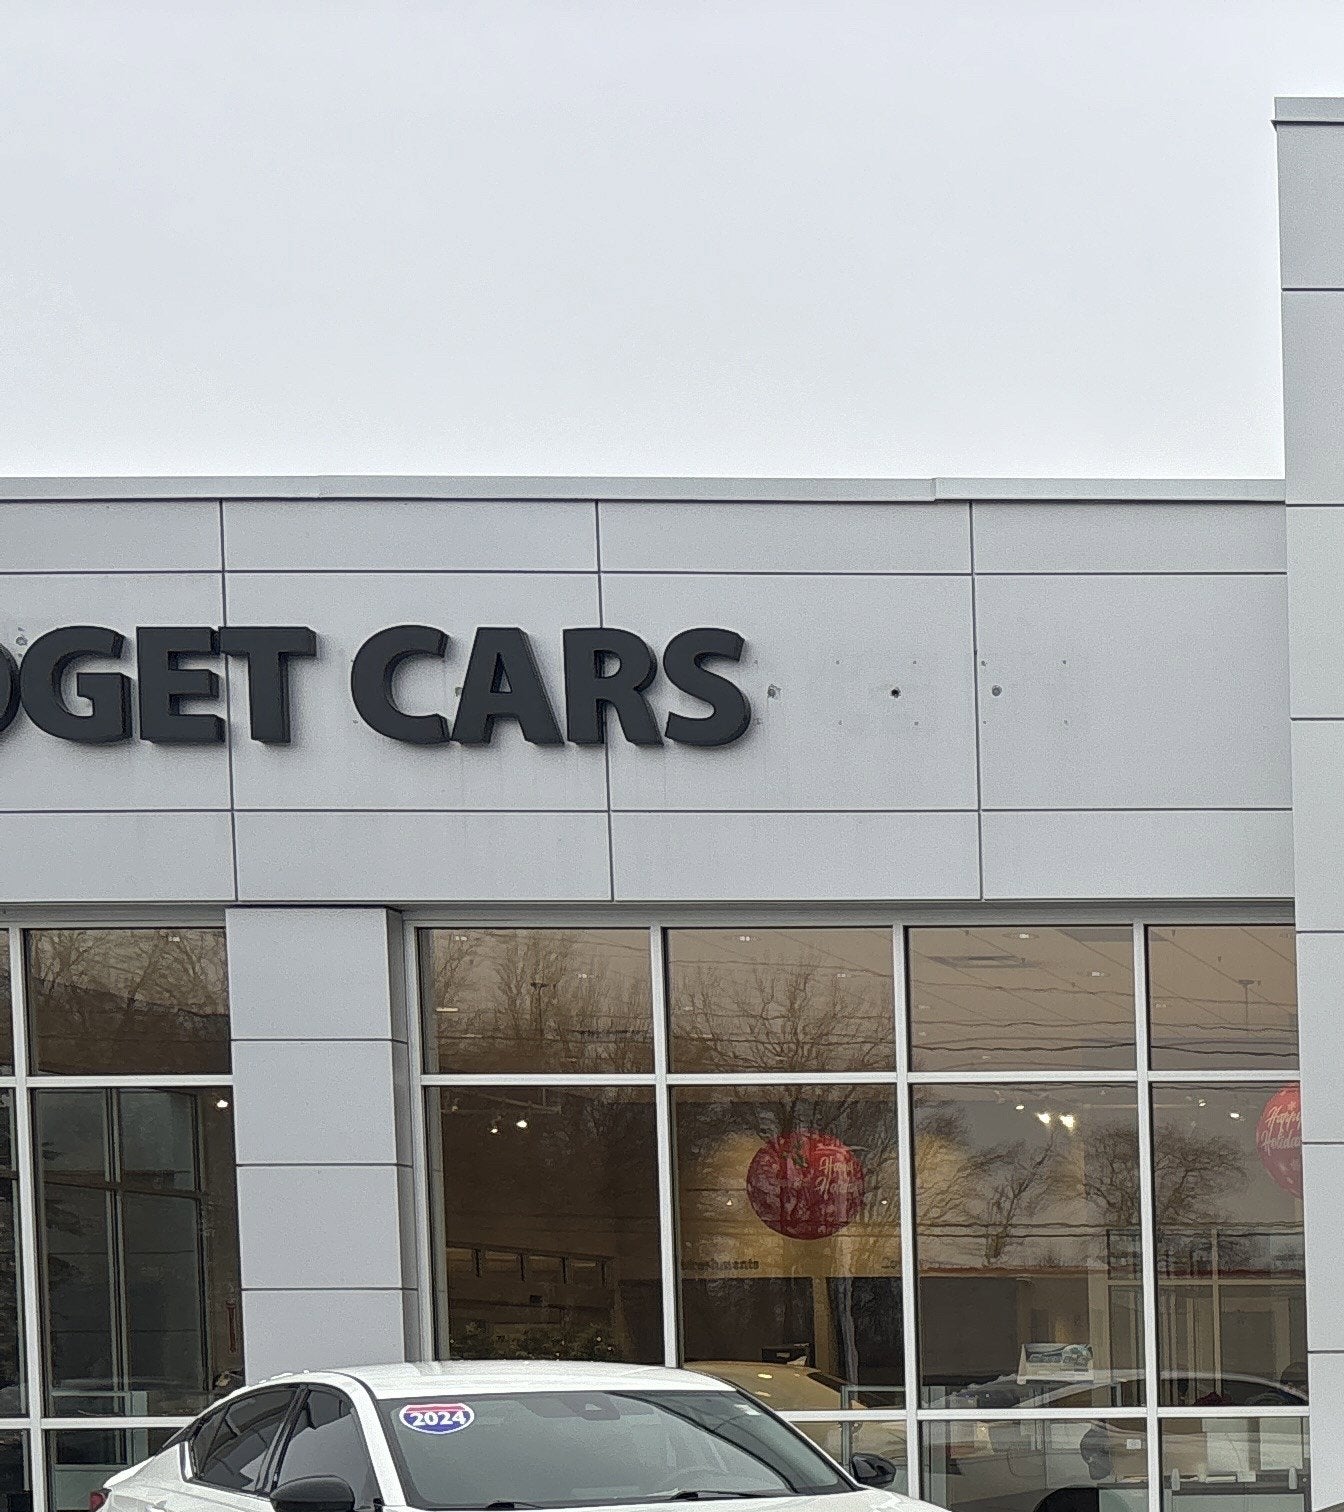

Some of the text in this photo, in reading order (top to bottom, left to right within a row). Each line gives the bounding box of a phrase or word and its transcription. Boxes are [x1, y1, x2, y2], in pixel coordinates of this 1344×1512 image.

[0, 624, 752, 748] GET CARS
[409, 1410, 467, 1427] 2024
